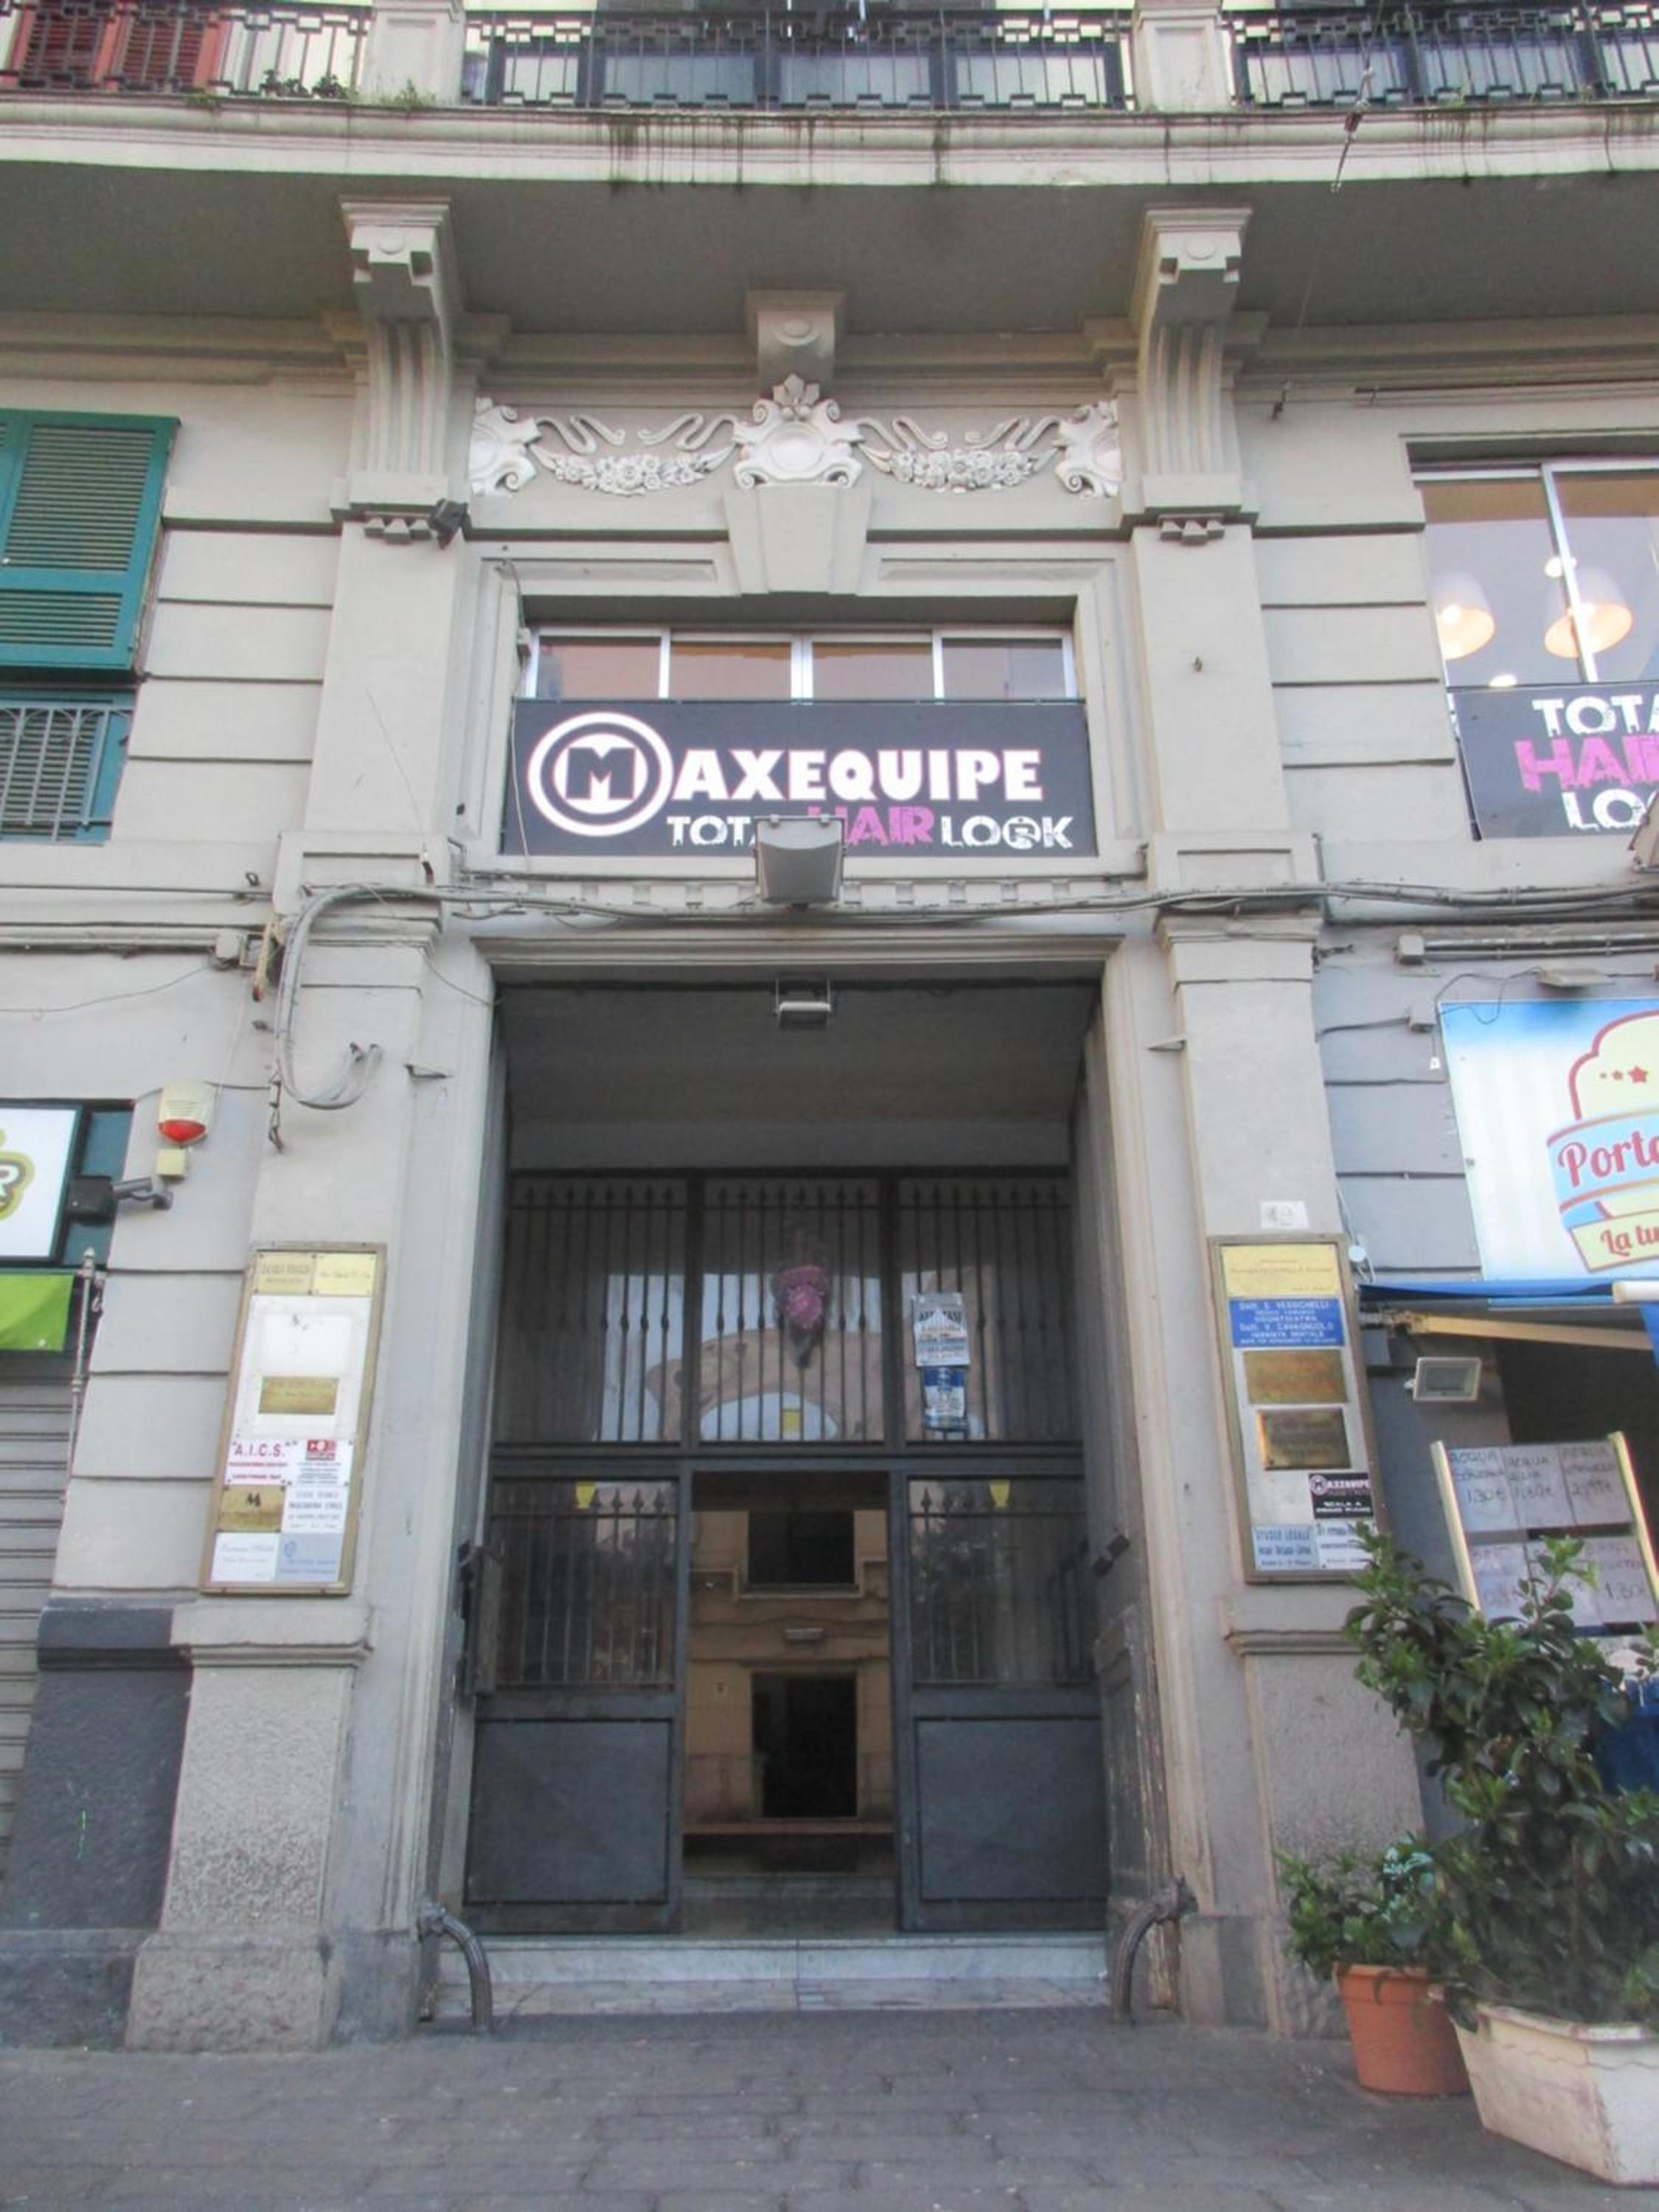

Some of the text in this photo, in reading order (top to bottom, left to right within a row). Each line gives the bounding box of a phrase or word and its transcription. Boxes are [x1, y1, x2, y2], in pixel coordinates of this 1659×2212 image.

[1561, 788, 1659, 831] LO
[667, 815, 758, 846] TOT
[1600, 1229, 1632, 1257] La
